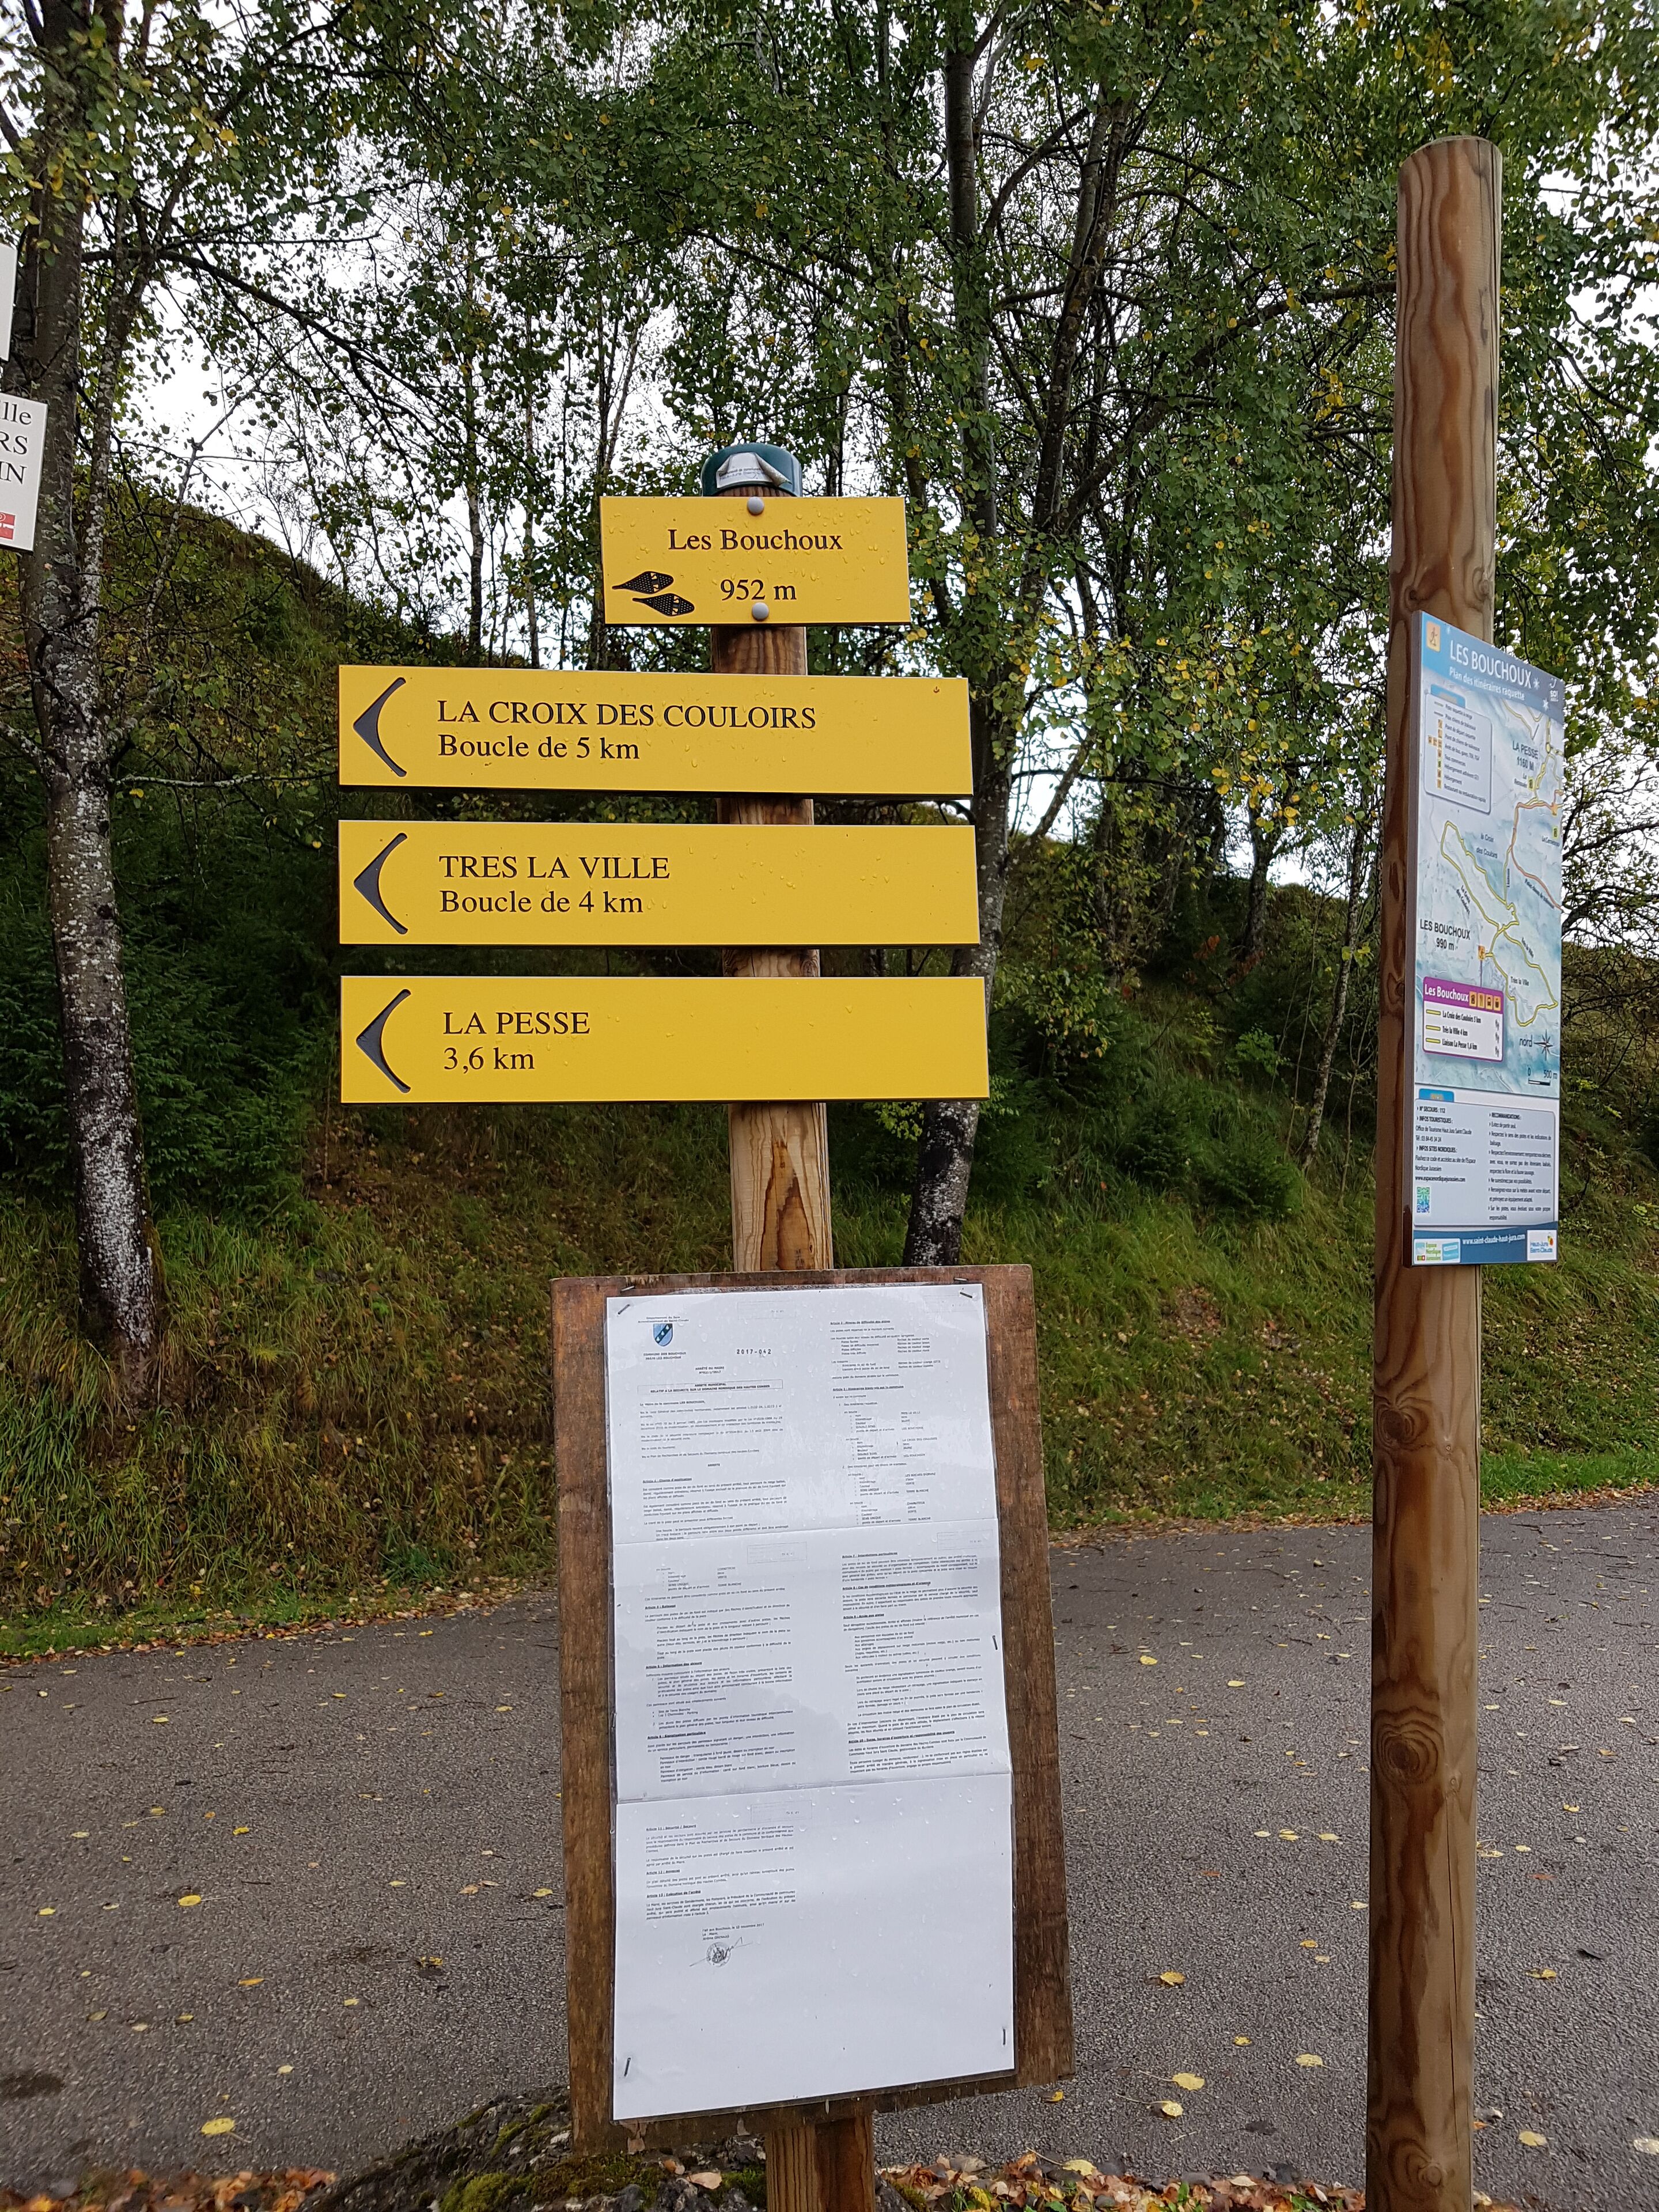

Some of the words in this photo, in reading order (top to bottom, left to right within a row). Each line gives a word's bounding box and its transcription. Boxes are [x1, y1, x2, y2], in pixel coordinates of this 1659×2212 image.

[667, 529, 711, 550] Les
[719, 529, 843, 550] Bouchoux
[720, 579, 766, 601] 952
[773, 585, 797, 600] m
[1450, 639, 1469, 666] LES
[1471, 650, 1532, 689] BOUCHOUX
[1449, 666, 1462, 681] Plan
[1463, 673, 1473, 685] des
[1502, 686, 1525, 701] raquette
[437, 700, 480, 722] LA
[489, 701, 588, 725] CROIX
[596, 703, 654, 726] DES
[664, 705, 816, 729] COULOIRS
[438, 734, 529, 757] Boucle
[537, 736, 567, 758] de
[576, 737, 590, 759] 5
[599, 737, 640, 759] km
[1513, 740, 1520, 752] LA
[1521, 744, 1538, 759] PESSE
[1483, 849, 1498, 859] Couloirs
[439, 855, 517, 878] TRES
[527, 857, 570, 878] LA
[578, 857, 671, 879] VILLE
[440, 890, 532, 912] Boucle
[540, 891, 570, 912] de
[578, 891, 594, 912] 4
[603, 891, 643, 913] km
[1420, 919, 1433, 931] LES
[1434, 922, 1471, 940] BOUCHOUX
[1436, 938, 1447, 949] 990
[1449, 942, 1455, 950] m
[1425, 984, 1435, 996] Les
[1437, 986, 1469, 1002] Bouchoux
[443, 1012, 487, 1035] LA
[495, 1012, 590, 1035] PESSE
[1446, 1011, 1455, 1020] Croix
[1461, 1014, 1474, 1023] Couloirs
[1442, 1038, 1454, 1047] Liaison
[1458, 1040, 1467, 1049] Pesse
[1472, 1042, 1478, 1050] km
[1519, 1034, 1533, 1047] nord
[444, 1047, 484, 1074] 3,6
[493, 1047, 536, 1070] km
[1527, 1067, 1531, 1076] 0
[1544, 1069, 1552, 1079] 500
